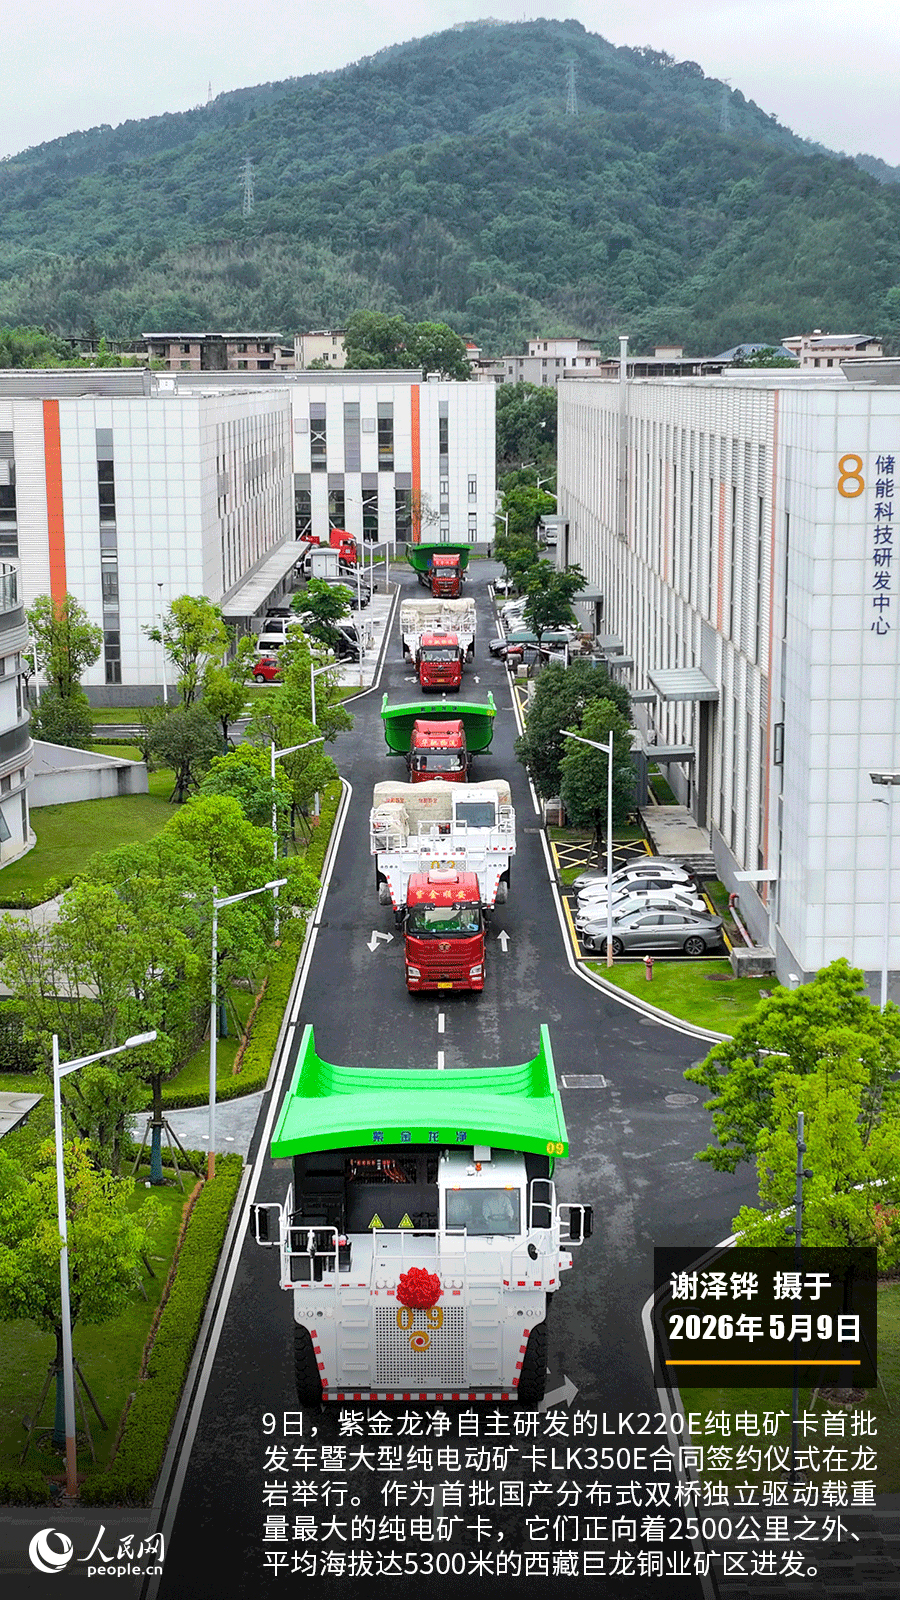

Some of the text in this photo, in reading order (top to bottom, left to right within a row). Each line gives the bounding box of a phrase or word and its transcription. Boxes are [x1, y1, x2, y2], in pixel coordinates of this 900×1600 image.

[837, 454, 865, 498] 8
[870, 455, 895, 635] 储能科技研发中心
[373, 1131, 467, 1142] 紫金龙净
[546, 1142, 564, 1155] 09
[396, 1305, 443, 1330] 09
